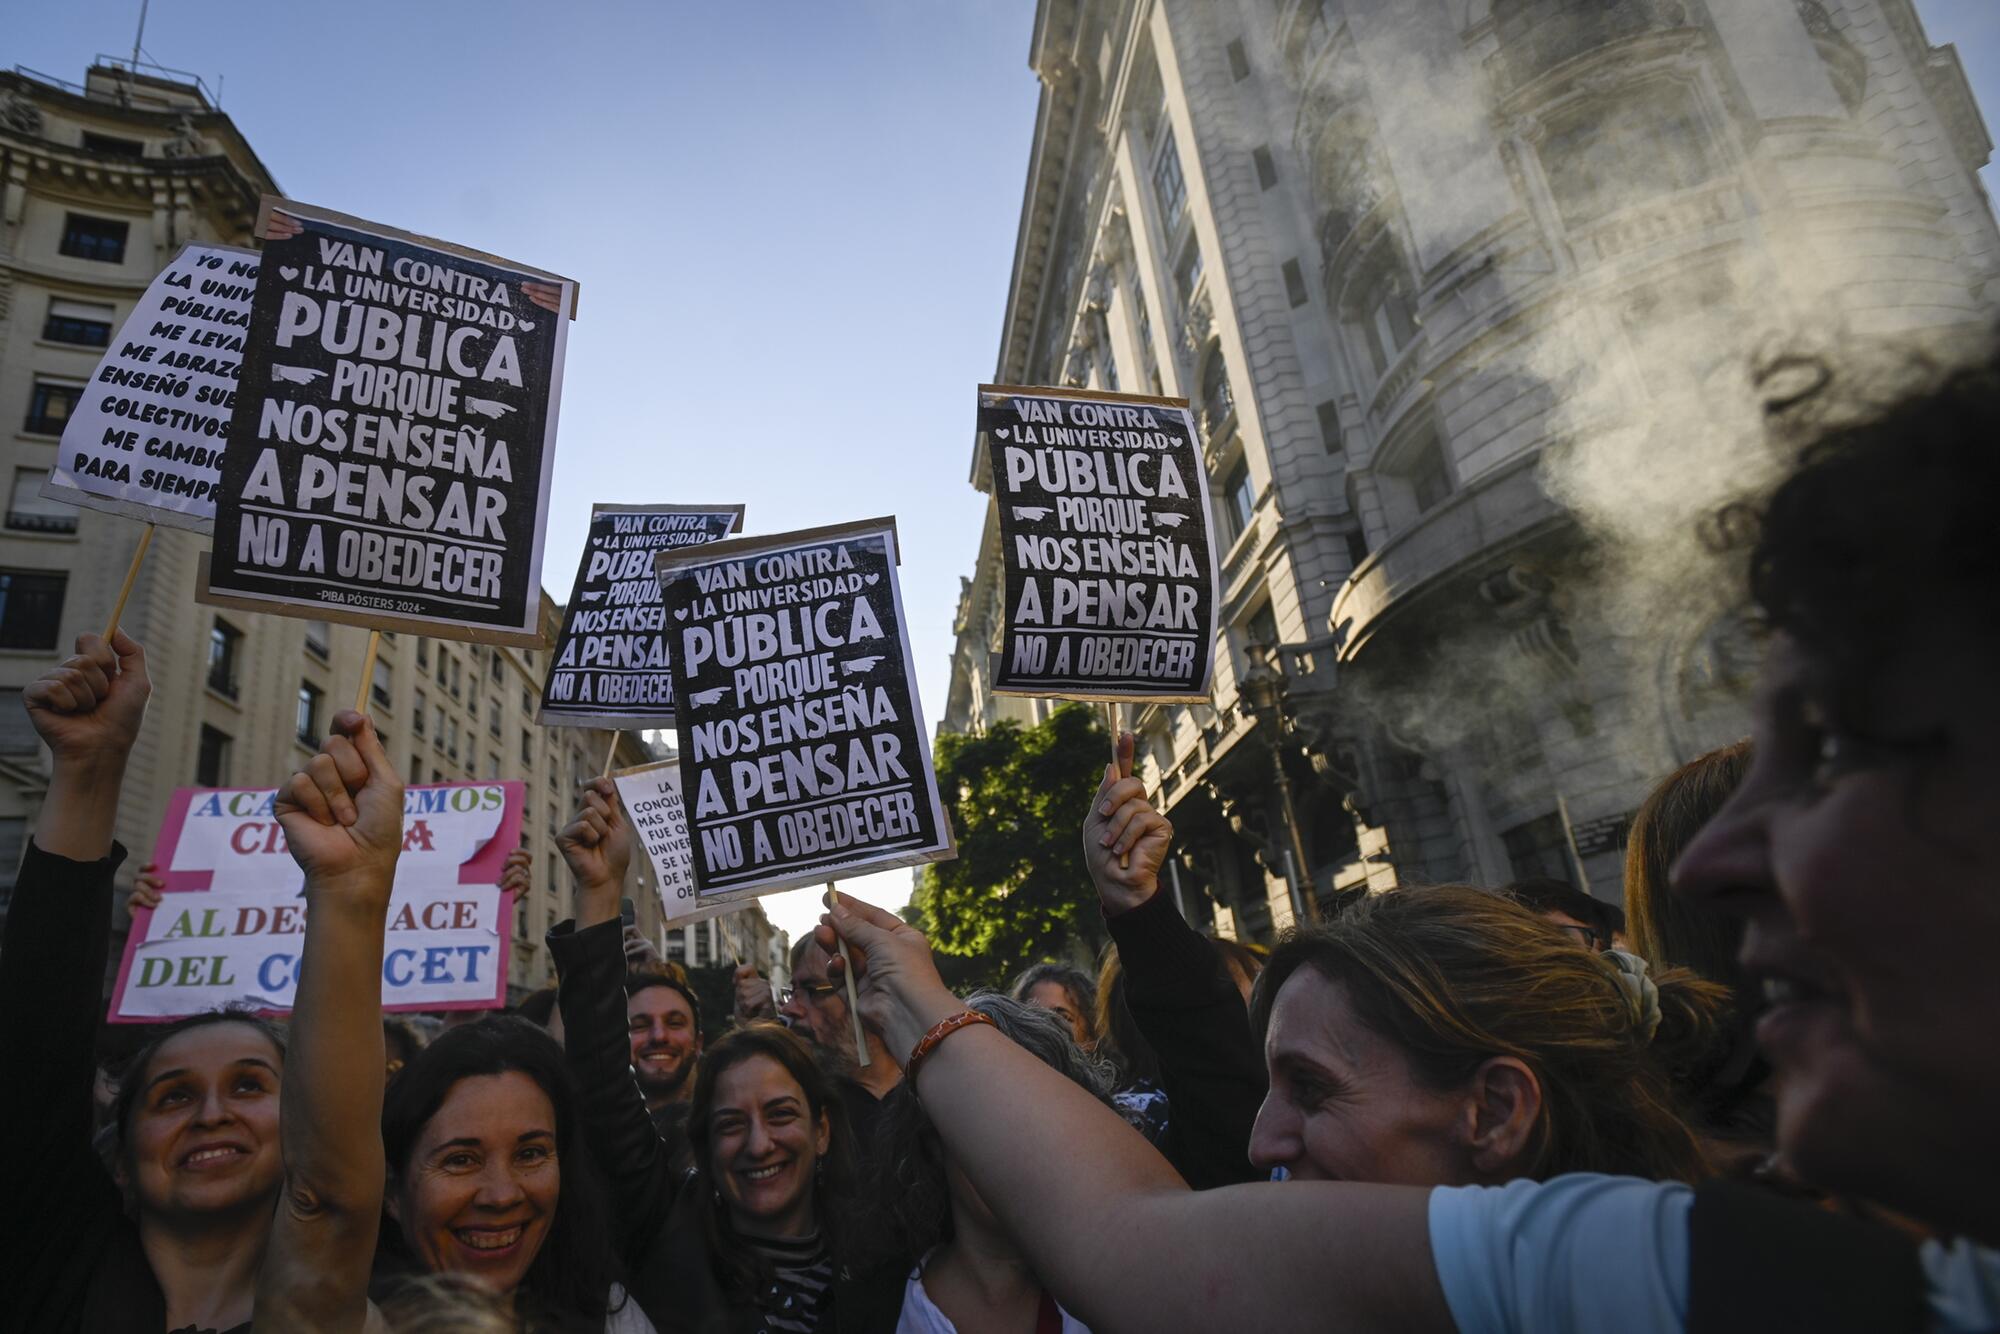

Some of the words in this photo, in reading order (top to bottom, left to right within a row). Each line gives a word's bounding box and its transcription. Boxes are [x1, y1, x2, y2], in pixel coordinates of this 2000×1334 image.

[196, 254, 223, 270] YO
[319, 237, 384, 276] VAN
[394, 257, 511, 307] CONTRA
[164, 271, 190, 290] LA
[200, 279, 256, 304] UNIV
[304, 266, 336, 294] LA
[344, 274, 515, 331] UNIVERSIDAD
[120, 342, 157, 362] ME
[150, 321, 186, 340] ME
[189, 328, 246, 354] LEVA
[275, 290, 523, 388] PÚBLICA
[98, 366, 192, 398] ENSEÑÓ
[330, 360, 461, 422] PORQUE
[100, 396, 232, 440] COLECTIVOS
[1013, 400, 1063, 426] VAN
[1070, 403, 1158, 429] CONTRA
[102, 427, 140, 452] ME
[1013, 424, 1038, 444] LA
[1043, 427, 1168, 450] UNIVERSIDAD
[74, 452, 130, 484] PARA
[1004, 446, 1189, 500] PÚBLICA
[241, 448, 285, 504] A
[296, 453, 508, 541] PENSAR
[614, 516, 646, 533] VAN
[649, 516, 707, 532] CONTRA
[1056, 496, 1151, 538] PORQUE
[238, 514, 289, 567] NO
[300, 524, 324, 574] A
[336, 530, 502, 598] OBEDECER
[603, 535, 620, 549] LA
[623, 532, 706, 548] UNIVERSIDAD
[694, 562, 747, 595] VAN
[754, 544, 855, 582] CONTRA
[347, 592, 394, 610] PÓSTERS
[692, 599, 717, 621] LA
[724, 573, 862, 613] UNIVERSIDAD
[1014, 576, 1045, 625] A
[1052, 577, 1198, 630] PENSAR
[557, 637, 576, 667] A
[580, 634, 670, 668] PENSA
[683, 595, 884, 679] PÚBLICA
[1011, 634, 1047, 675] NO
[1052, 636, 1070, 675] A
[1078, 636, 1195, 679] OBEDECER
[550, 673, 575, 700] NO
[579, 674, 592, 702] A
[734, 651, 839, 706] PORQUE
[658, 781, 673, 794] LA
[696, 768, 728, 820] A
[730, 732, 910, 812] PENSAR
[637, 813, 664, 828] MÁS
[648, 827, 672, 841] FUE
[701, 824, 744, 872] NO
[754, 819, 775, 864] A
[778, 790, 920, 858] OBEDECER
[662, 857, 678, 869] SE
[663, 873, 680, 886] DE
[164, 908, 225, 938] AL
[136, 956, 234, 988] DEL
